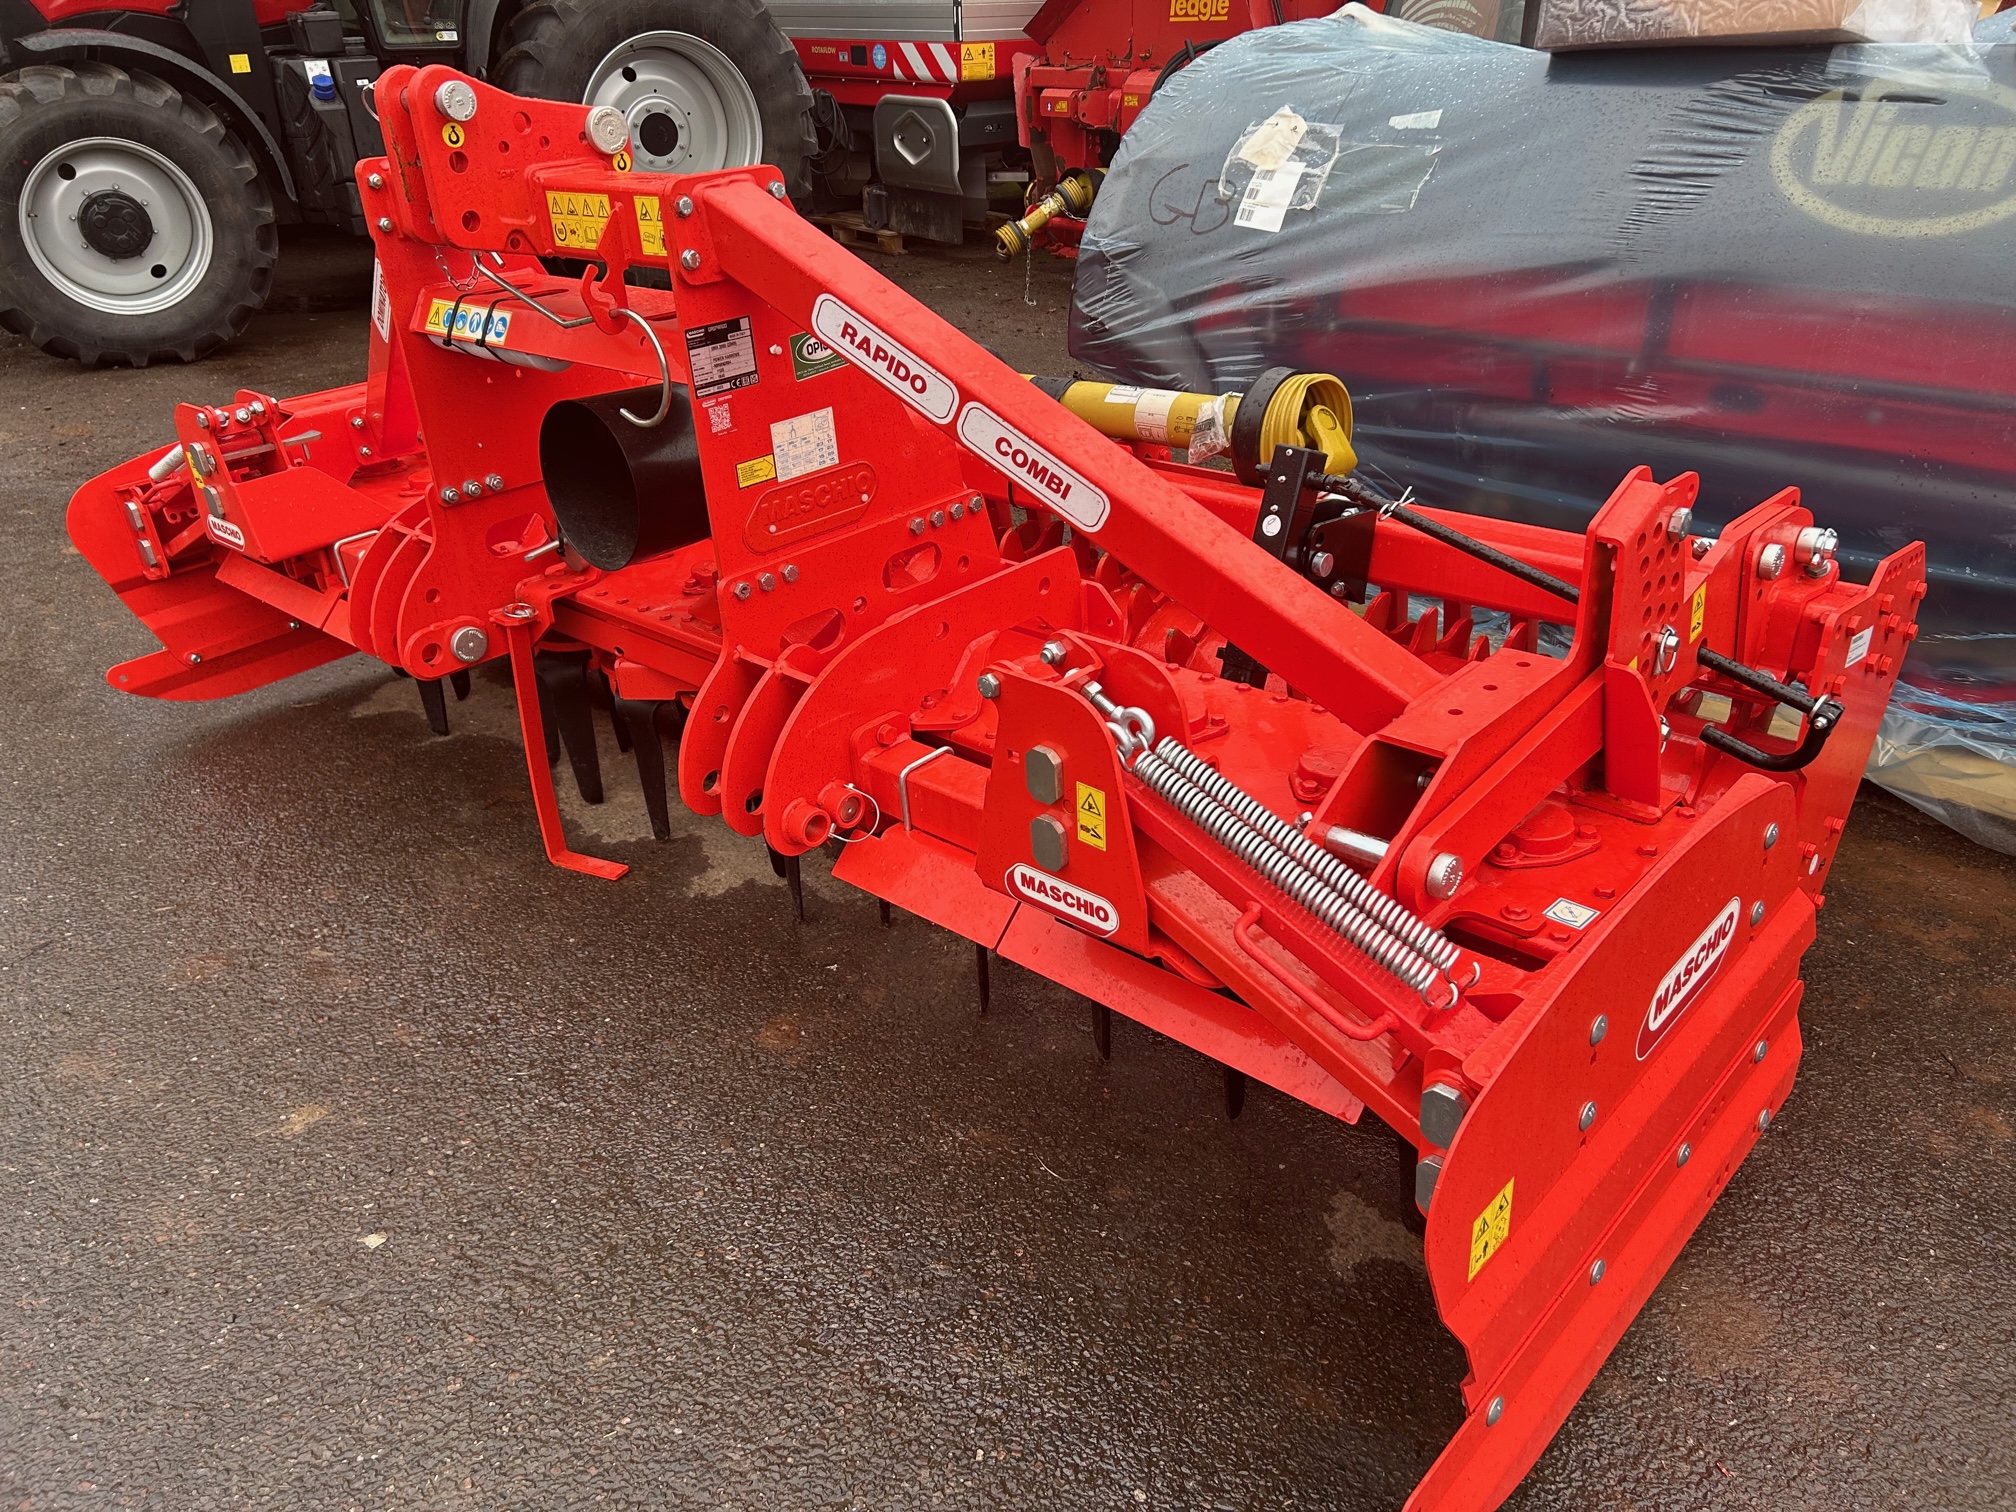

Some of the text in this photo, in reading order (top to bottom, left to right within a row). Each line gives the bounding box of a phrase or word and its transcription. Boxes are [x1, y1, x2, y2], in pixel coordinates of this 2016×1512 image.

[811, 45, 836, 54] ROTAFLOW
[840, 321, 927, 394] RAPIDO
[995, 436, 1072, 501] COMBI
[761, 471, 871, 526] MASCHIO
[210, 519, 242, 541] MASCHIO
[1020, 871, 1110, 923] MASCHIO
[1652, 911, 1735, 1024] MASCHIO
